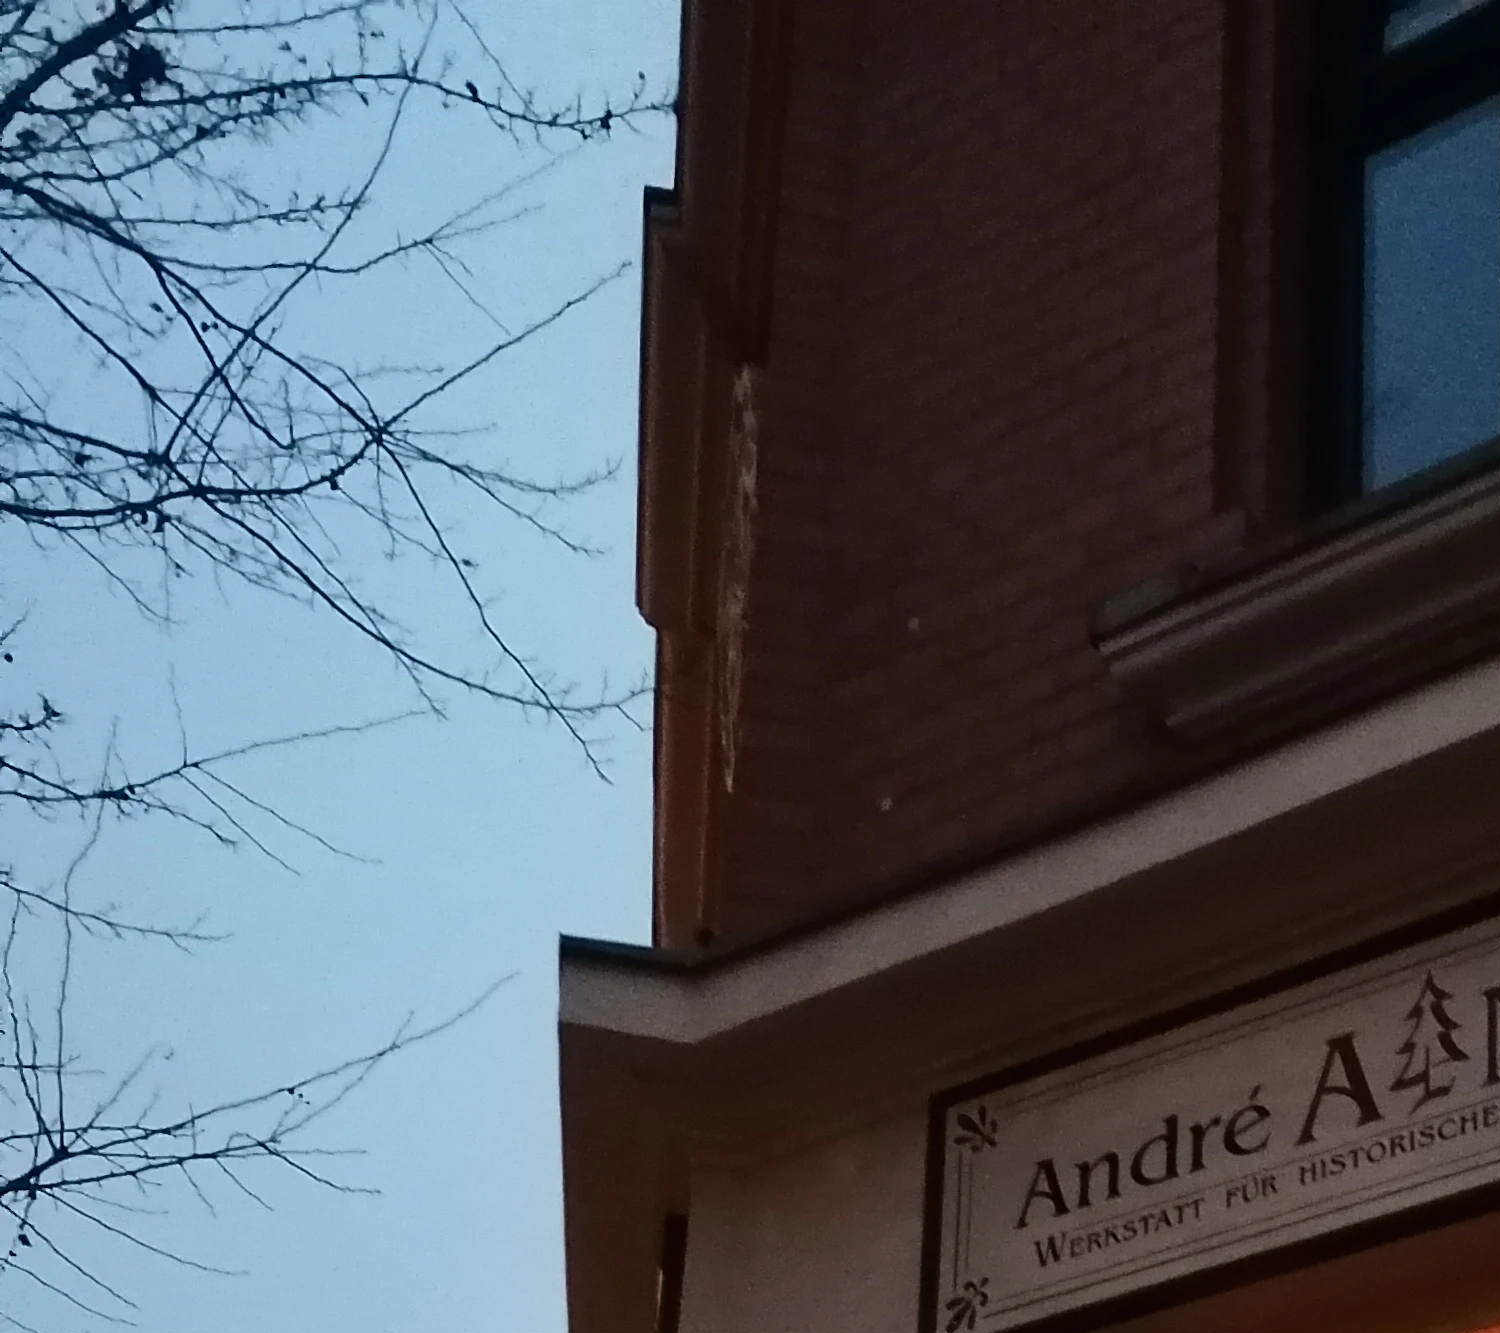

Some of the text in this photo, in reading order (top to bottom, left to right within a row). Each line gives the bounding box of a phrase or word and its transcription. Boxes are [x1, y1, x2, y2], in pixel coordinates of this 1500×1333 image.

[1013, 1084, 1272, 1231] André
[1294, 1030, 1385, 1147] A
[1032, 1196, 1207, 1268] WERKSTATT
[1225, 1173, 1280, 1210] FÜR
[1299, 1105, 1500, 1189] HISTORISCHE
